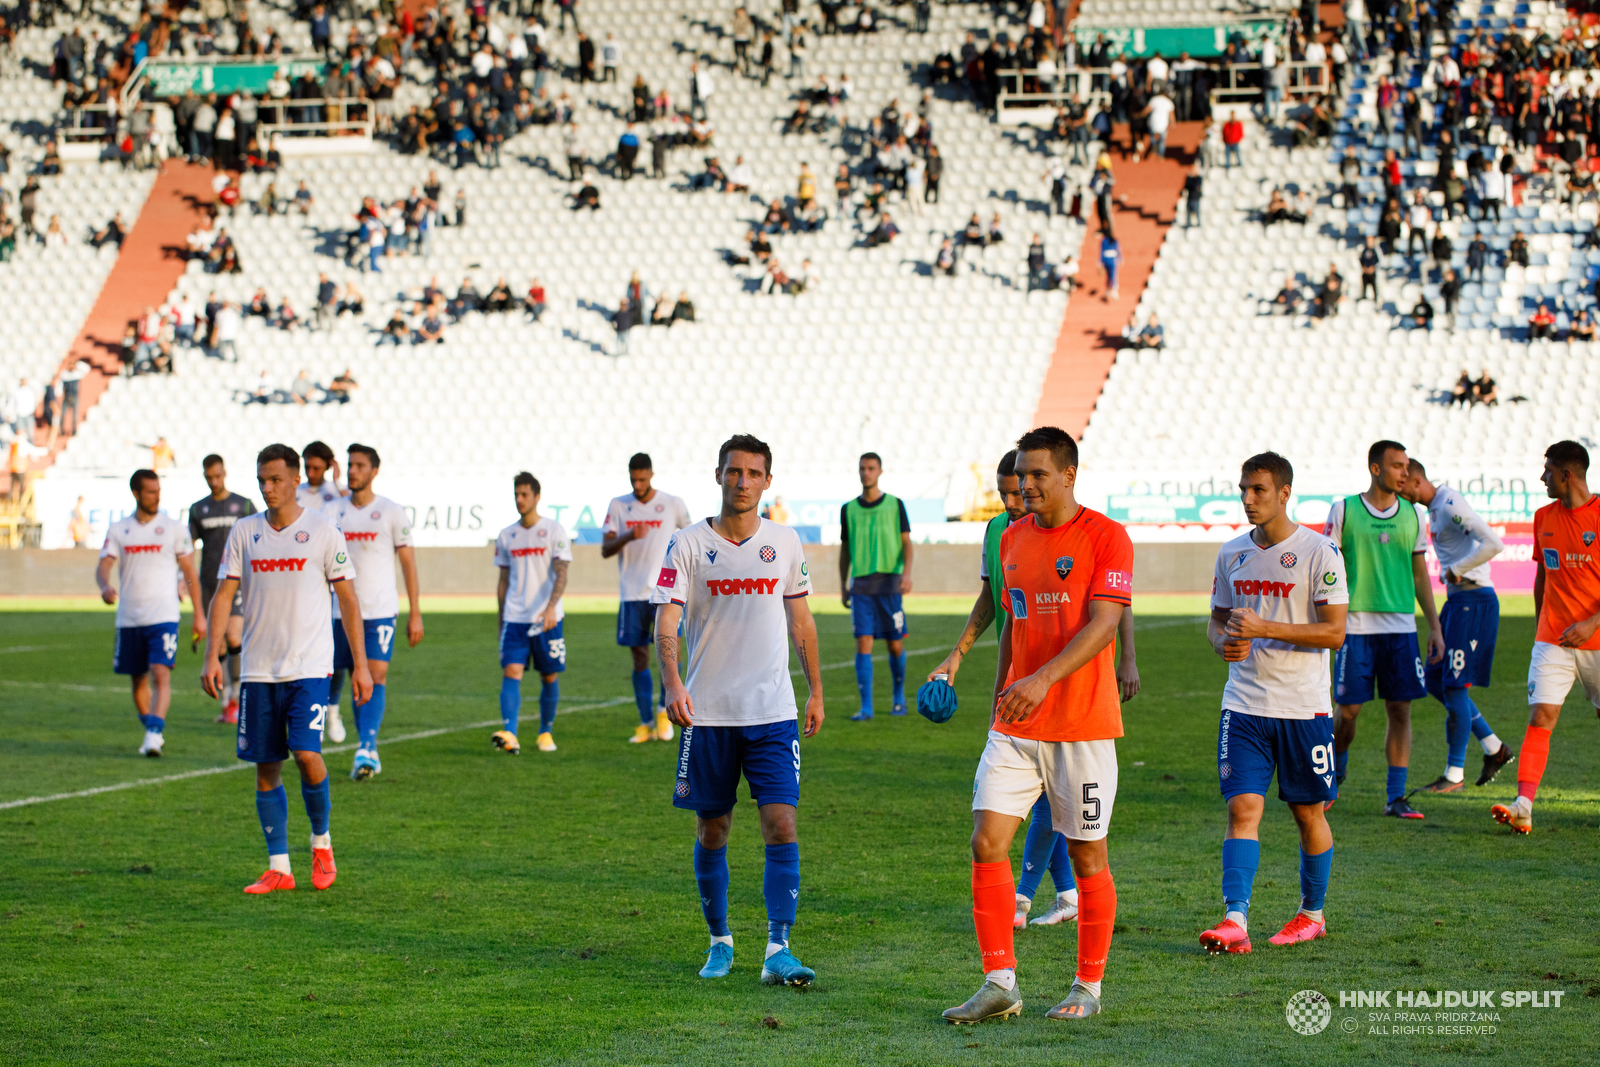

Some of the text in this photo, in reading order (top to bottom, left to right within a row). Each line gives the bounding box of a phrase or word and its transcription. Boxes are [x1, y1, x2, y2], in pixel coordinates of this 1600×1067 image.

[1160, 475, 1237, 496] ruda
[344, 531, 378, 542] OMMY
[124, 544, 164, 555] TOMMY
[511, 546, 548, 558] TOMMY
[1566, 553, 1593, 562] KRKA
[250, 558, 308, 573] TOMMY
[706, 578, 780, 596] TOMMY
[1233, 580, 1296, 598] TOMMY
[1036, 592, 1071, 604] KRKA
[162, 632, 178, 652] 14
[377, 624, 394, 646] 17
[549, 638, 566, 659] 35
[1415, 656, 1425, 679] 6
[1448, 648, 1465, 671] 18
[1311, 742, 1335, 775] 91
[1082, 782, 1101, 821] 5
[981, 949, 1005, 957] JAKO
